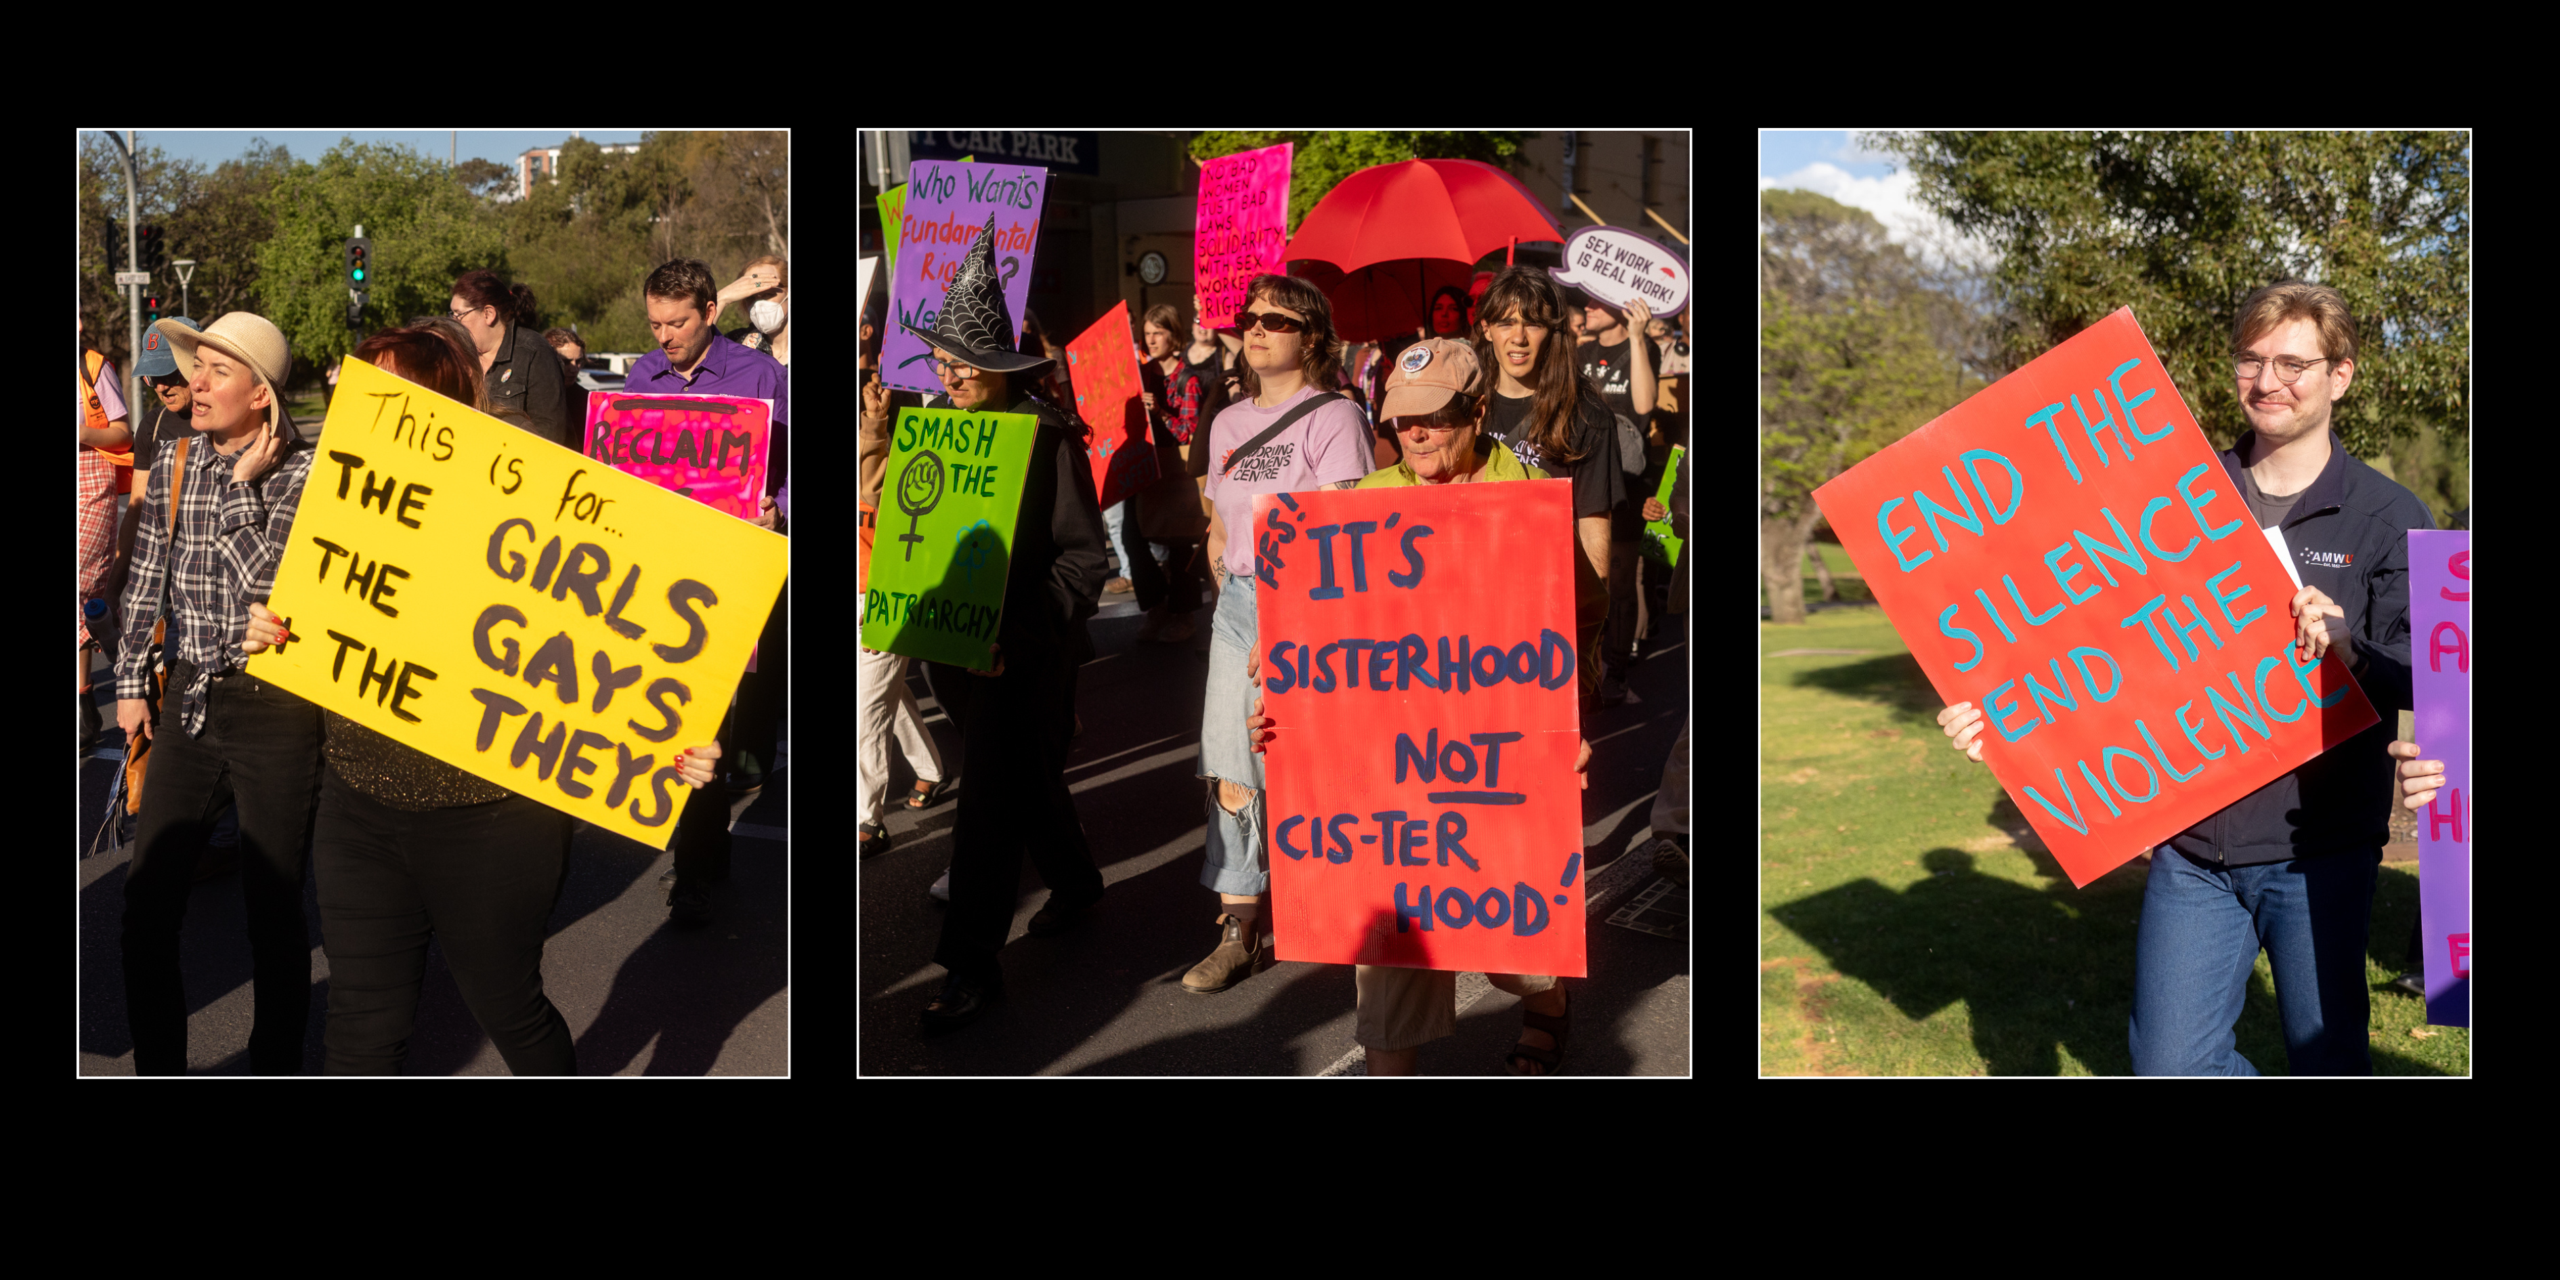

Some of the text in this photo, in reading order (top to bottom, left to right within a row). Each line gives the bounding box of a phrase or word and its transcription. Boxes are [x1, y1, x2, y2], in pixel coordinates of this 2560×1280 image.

[1010, 132, 1080, 164] PARK
[1206, 158, 1257, 183] NO BAD
[913, 165, 1039, 209] Who Wants
[1201, 190, 1267, 216] JUST BAD
[1204, 180, 1250, 198] WOMEN
[1199, 226, 1283, 257] SOLIDARITY
[1201, 215, 1232, 234] LAWS
[1198, 254, 1262, 275] WITH SEX
[1577, 251, 1592, 268] IS
[1592, 258, 1626, 284] REAL
[1631, 274, 1675, 304] WORK!
[1585, 235, 1654, 275] SEX WORK
[146, 332, 159, 351] B
[366, 391, 455, 462] This
[488, 442, 524, 495] is
[589, 420, 751, 476] RECLAIM
[897, 415, 998, 458] SMASH
[1097, 438, 1115, 458] WE
[1240, 455, 1291, 471] WOMEN'S
[950, 463, 998, 497] THE
[1233, 468, 1279, 482] CENTRE
[1876, 357, 2174, 573] END THE
[329, 449, 719, 664] THE GIRLS
[1255, 492, 1306, 590] FFS!
[1306, 511, 1435, 600] IT'S
[1939, 463, 2243, 672] SILENCE
[2312, 552, 2354, 564] AMWU
[312, 536, 693, 744] THE GAYS
[866, 588, 999, 642] PATRIARCHY
[1265, 629, 1576, 694] SISTERHOOD
[1981, 561, 2267, 743] END THE
[326, 629, 439, 725] THE
[470, 688, 685, 829] THEYS
[2023, 638, 2350, 835] VIOLENCE
[1395, 727, 1524, 788] NOT
[1275, 810, 1481, 873] CIS-TER
[1394, 852, 1582, 937] HOOD!
